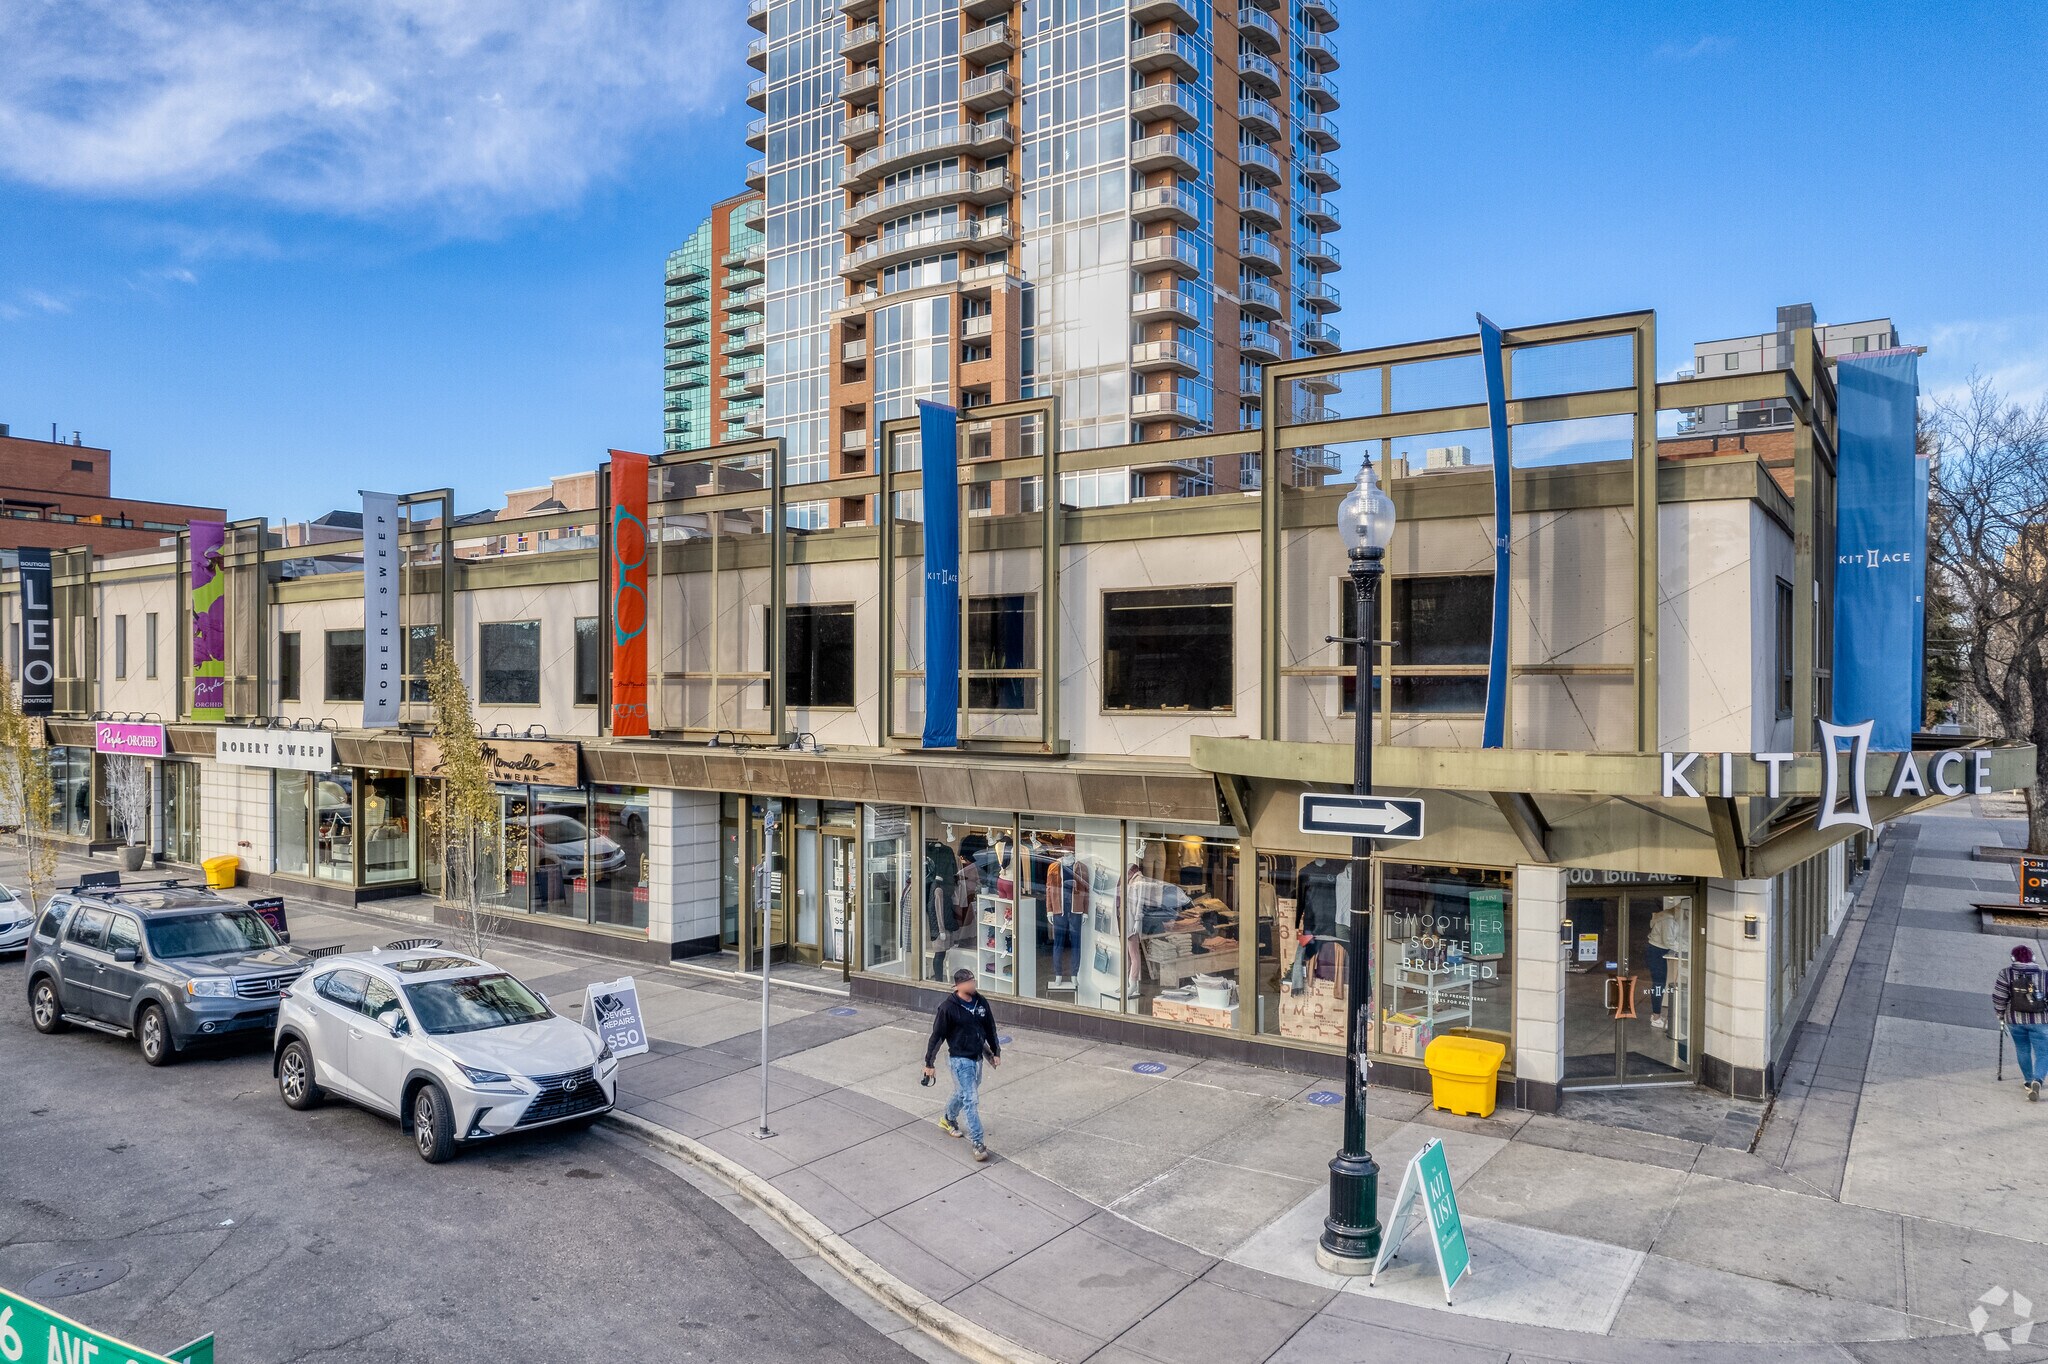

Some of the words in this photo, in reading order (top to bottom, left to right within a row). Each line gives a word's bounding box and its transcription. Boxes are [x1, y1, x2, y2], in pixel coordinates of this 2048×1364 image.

[378, 515, 388, 594] SWEEP
[1840, 555, 1863, 564] KIT
[1882, 553, 1910, 562] ACE
[928, 572, 940, 580] KIT
[379, 610, 388, 706] ROBERT
[126, 734, 159, 748] ORCHID
[222, 741, 269, 754] ROBERT
[278, 743, 324, 758] SWEEP
[1661, 752, 1794, 799] KIT
[1891, 749, 1993, 798] ACE
[1567, 868, 1594, 883] 00
[2024, 896, 2041, 904] 245
[1394, 911, 1502, 934] SMOOTHER
[1411, 935, 1490, 956] SOFTER.
[1402, 957, 1499, 980] BRUSHED.
[603, 1015, 636, 1030] REPAIRS
[604, 1007, 631, 1020] DEVICE
[607, 1029, 640, 1050] $50
[1429, 1170, 1446, 1203] KIT
[1433, 1192, 1453, 1229] LIST
